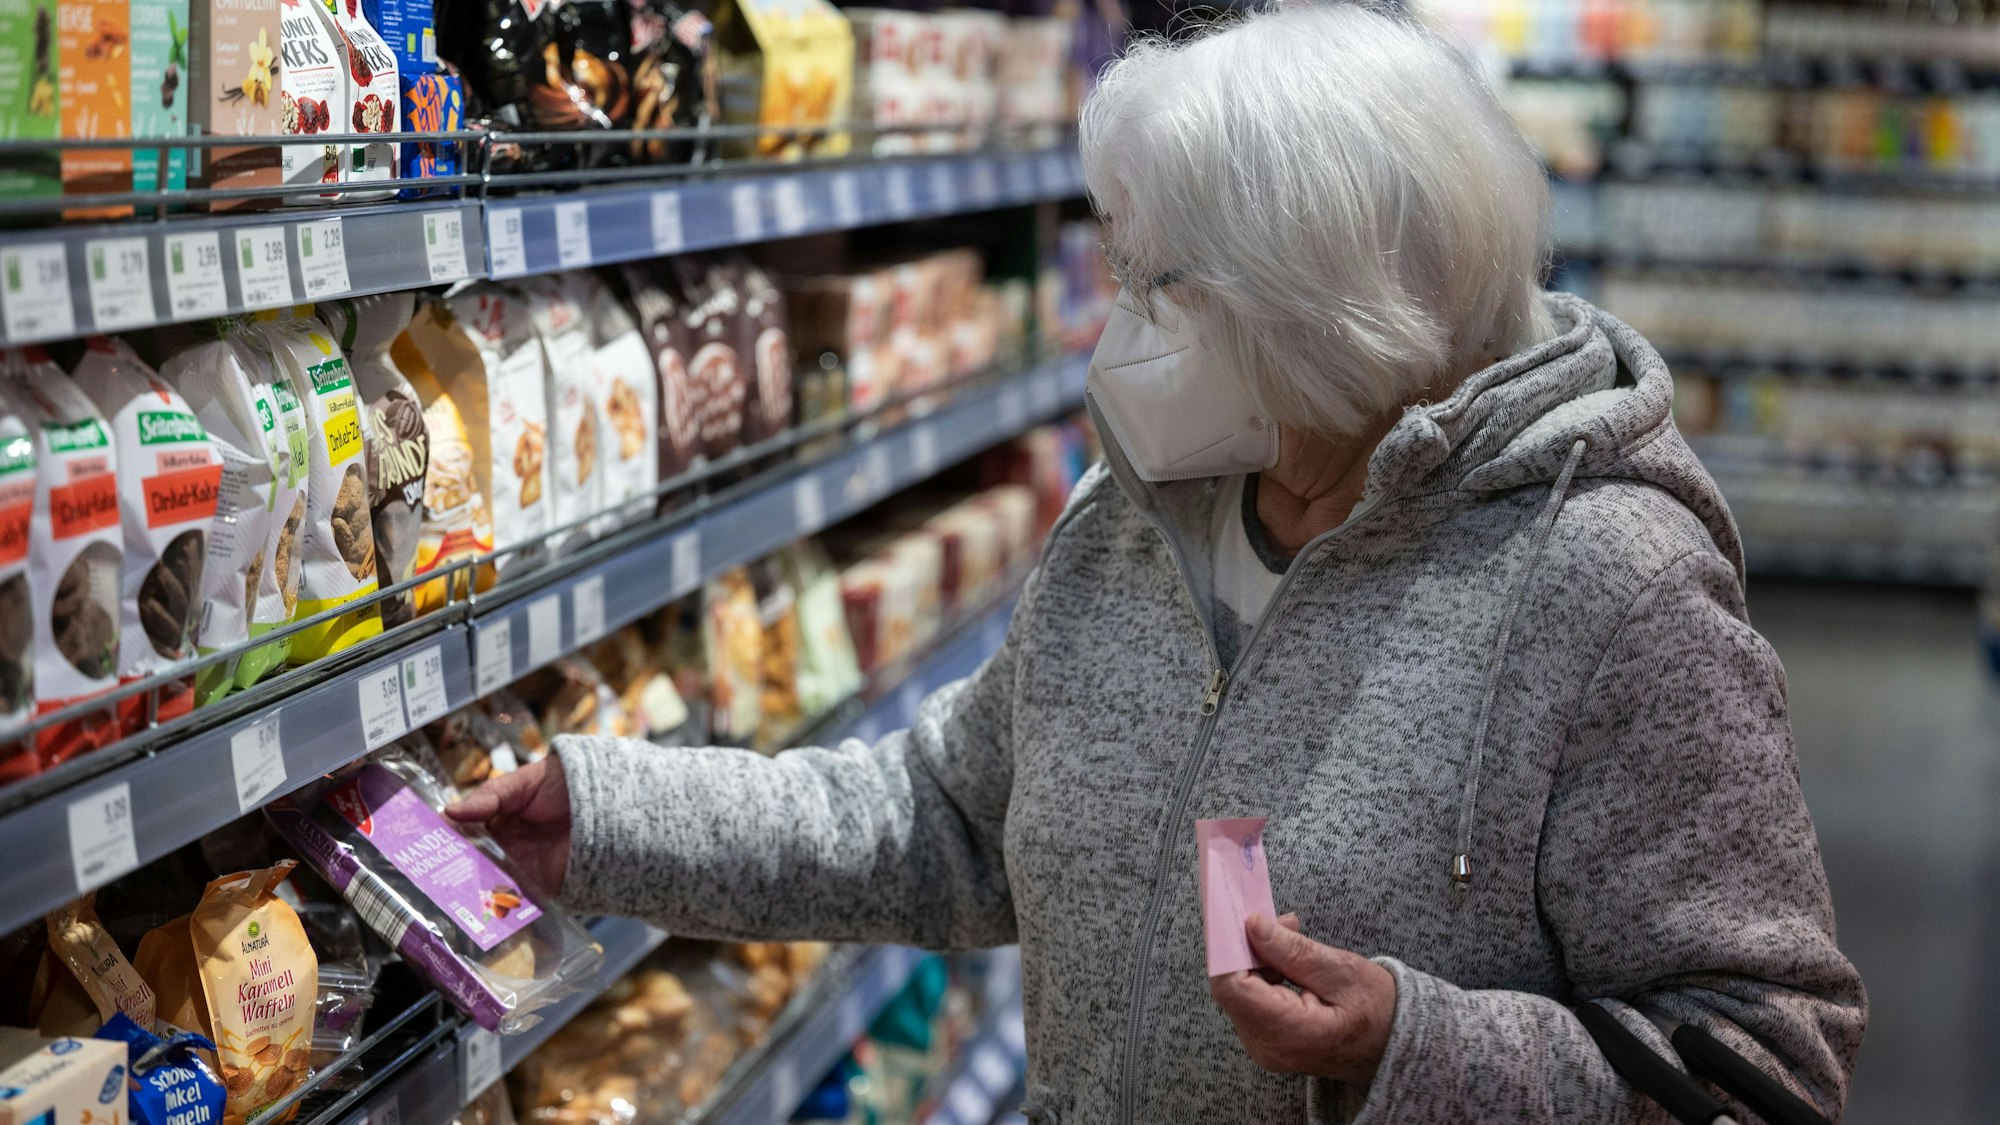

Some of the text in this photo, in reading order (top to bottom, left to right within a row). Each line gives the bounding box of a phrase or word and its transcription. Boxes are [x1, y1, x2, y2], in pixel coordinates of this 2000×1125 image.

[282, 38, 328, 68] KEKS
[359, 45, 393, 72] KEKS
[265, 241, 283, 263] 2,99
[324, 228, 340, 251] 2,29
[382, 676, 398, 700] 3,09
[394, 827, 457, 867] MANDEL
[241, 933, 270, 955] ALNATURA
[249, 956, 273, 980] Mini
[238, 969, 294, 1004] Karamell
[241, 994, 295, 1024] Waffeln
